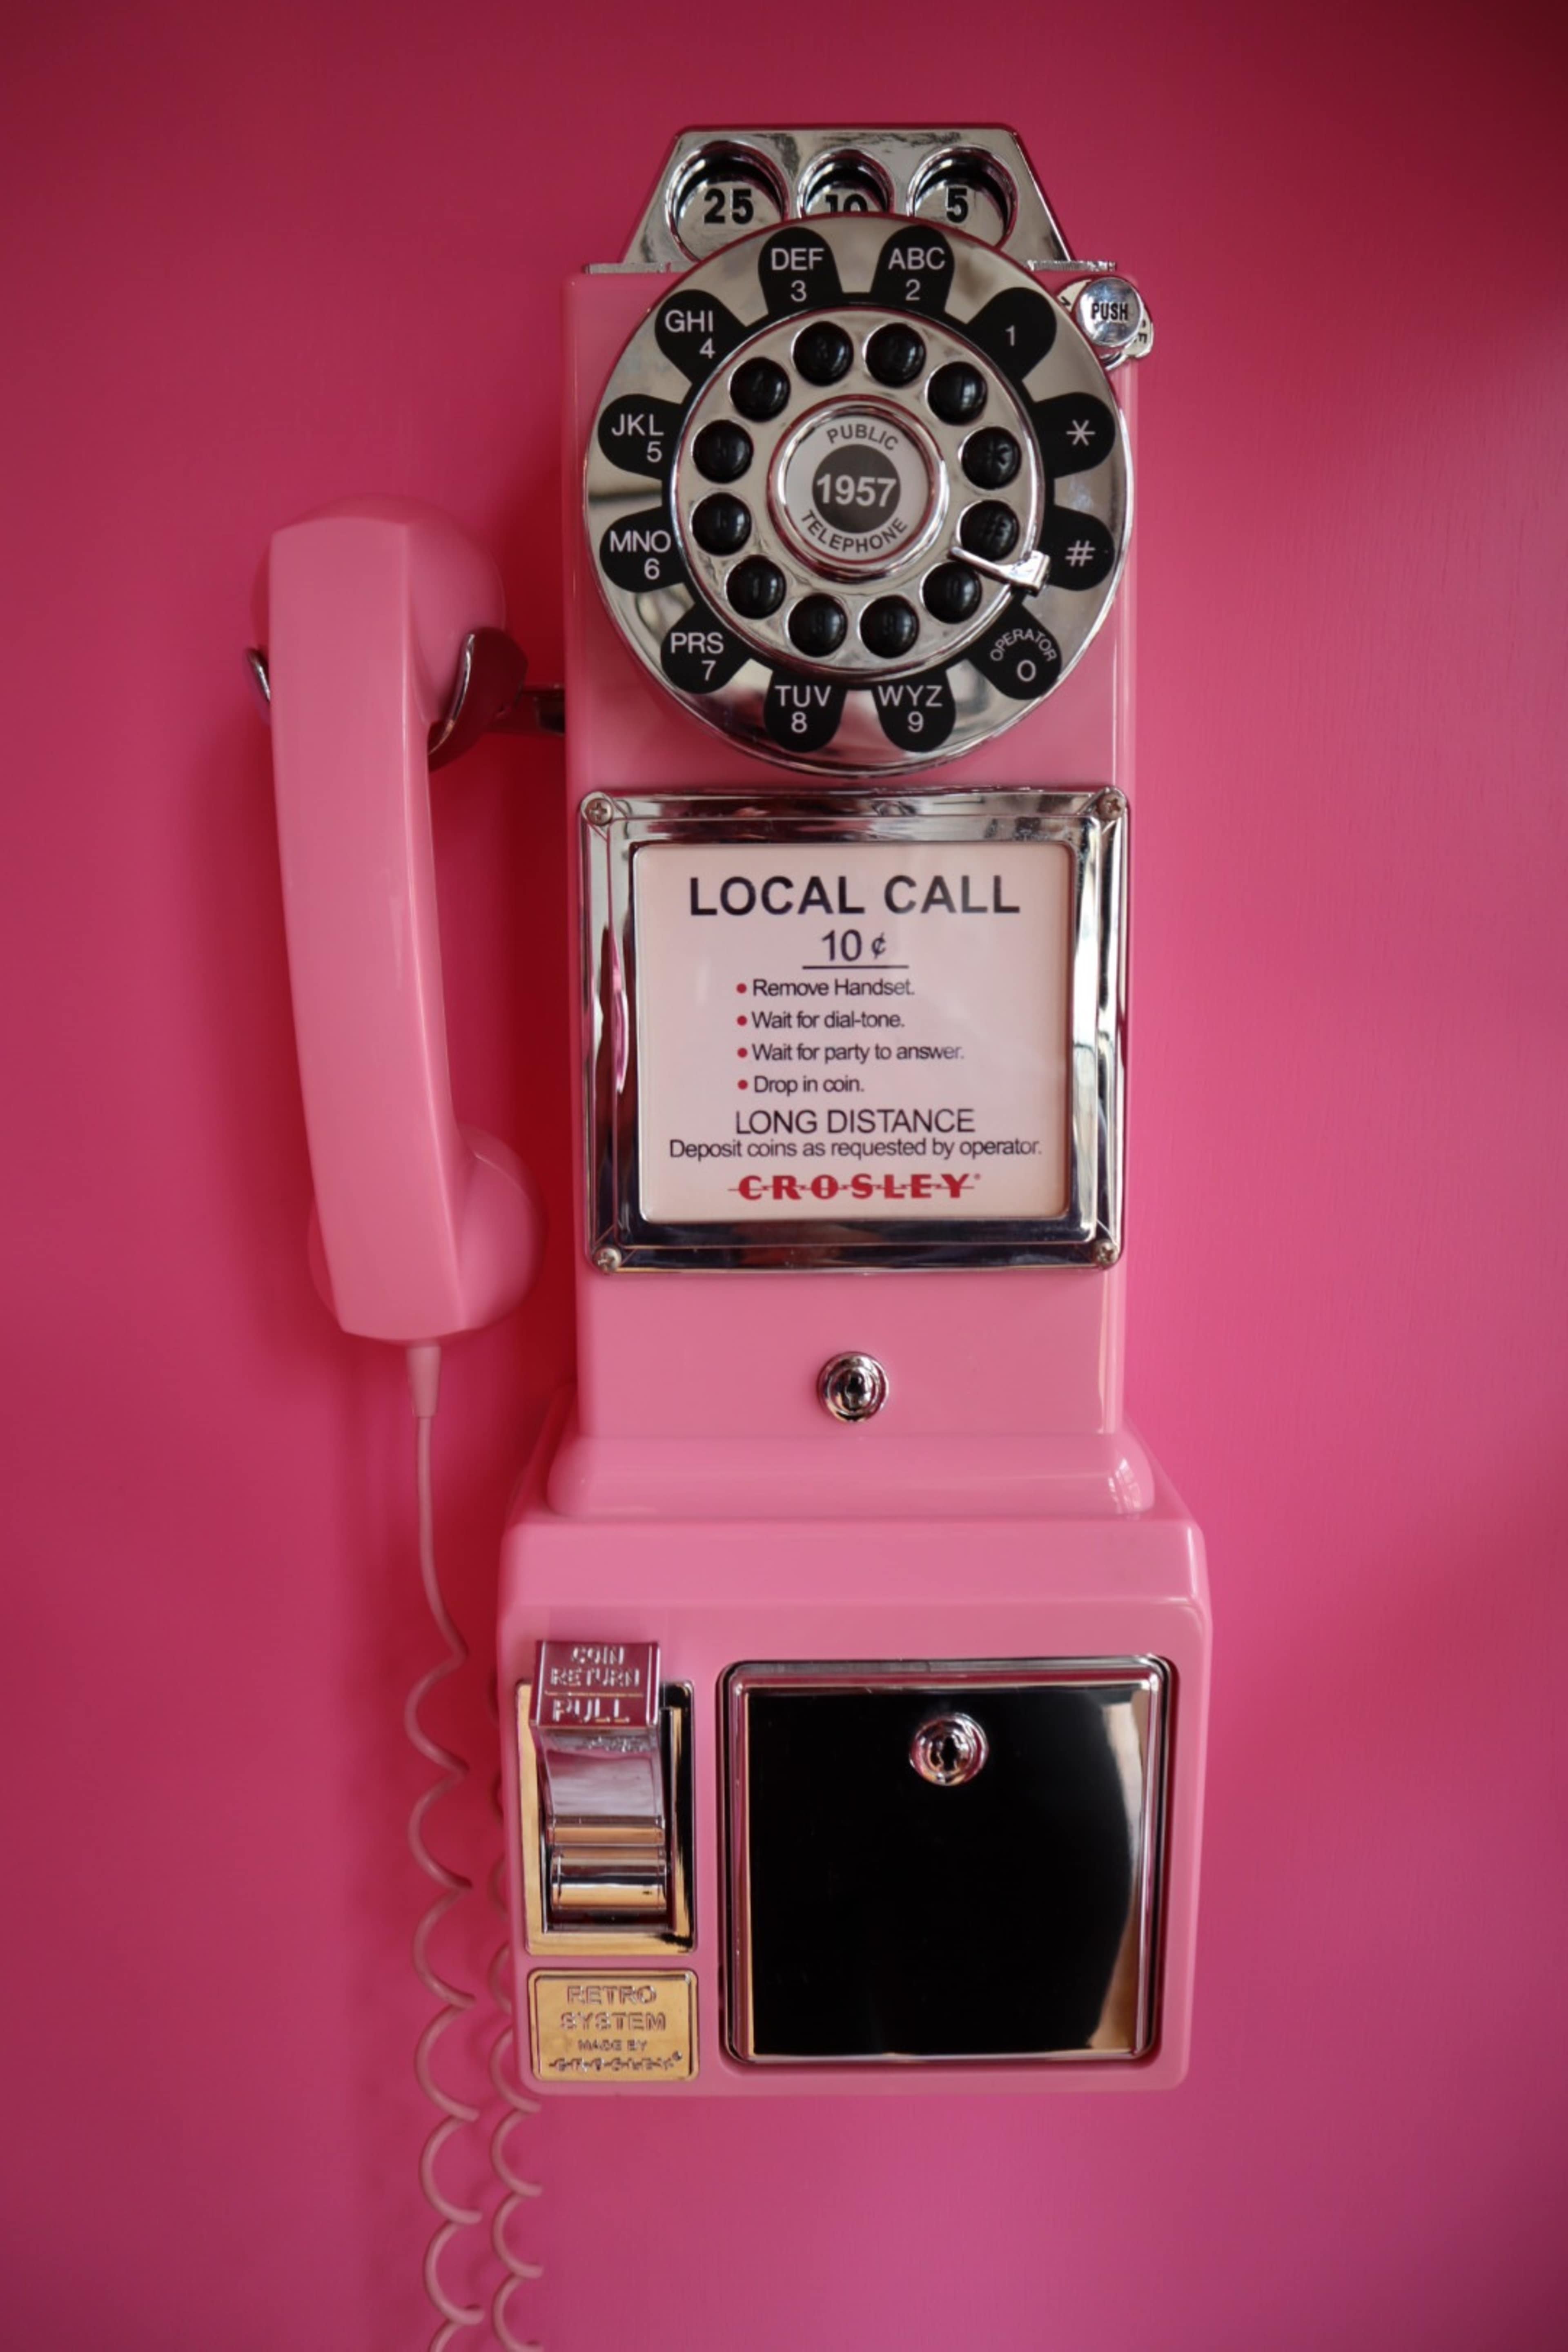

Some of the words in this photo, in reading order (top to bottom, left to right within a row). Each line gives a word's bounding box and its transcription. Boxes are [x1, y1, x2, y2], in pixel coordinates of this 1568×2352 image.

[703, 188, 754, 224] 25
[946, 188, 968, 223] 5
[771, 248, 824, 270] DEF
[888, 247, 945, 270] ABC
[791, 280, 806, 302] 3
[906, 278, 920, 301] 2
[665, 310, 713, 332] GHI
[1091, 303, 1129, 321] PUSH
[1006, 325, 1015, 346] 1
[699, 338, 715, 359] 4
[611, 414, 664, 436] JKL
[826, 423, 898, 451] PUBLIC
[647, 441, 662, 463] 5
[817, 473, 897, 508] 1957
[610, 530, 671, 552] MNO
[801, 509, 908, 553] TELEPHONE
[644, 558, 659, 579] 6
[671, 632, 724, 654] PRS
[990, 628, 1057, 662] OPERATOR
[702, 660, 716, 681] 7
[775, 685, 831, 707] TUV
[878, 685, 942, 707] WYZ
[791, 711, 807, 733] 8
[908, 711, 924, 732] 9
[690, 875, 865, 916] LOCAL
[884, 875, 1020, 914] CALL
[822, 929, 862, 962] 10
[753, 978, 829, 997] Remove
[835, 978, 915, 996] Handset.
[751, 1011, 792, 1029] Wait
[796, 1010, 820, 1029] for
[824, 1011, 905, 1029] dial-tone.
[752, 1043, 793, 1061] Wait
[796, 1042, 820, 1061] for
[824, 1044, 870, 1065] party
[874, 1044, 892, 1060] to
[896, 1045, 965, 1060] answer.
[754, 1075, 798, 1097] Drop
[803, 1076, 818, 1092] in
[823, 1076, 864, 1093] coin.
[736, 1109, 817, 1135] LONG
[827, 1109, 975, 1134] DISTANCE
[670, 1139, 742, 1162] Deposit
[747, 1143, 797, 1157] coins
[802, 1143, 826, 1156] as
[831, 1137, 927, 1160] requested
[932, 1137, 955, 1160] by
[959, 1138, 1042, 1159] operator.
[571, 1646, 625, 1664] COIN
[550, 1667, 640, 1687] RETURN
[552, 1697, 630, 1723] PULL
[567, 1985, 657, 2005] RETRO
[560, 2012, 666, 2031] SYSTEM
[577, 2039, 623, 2051] MADE
[627, 2040, 648, 2051] BY
